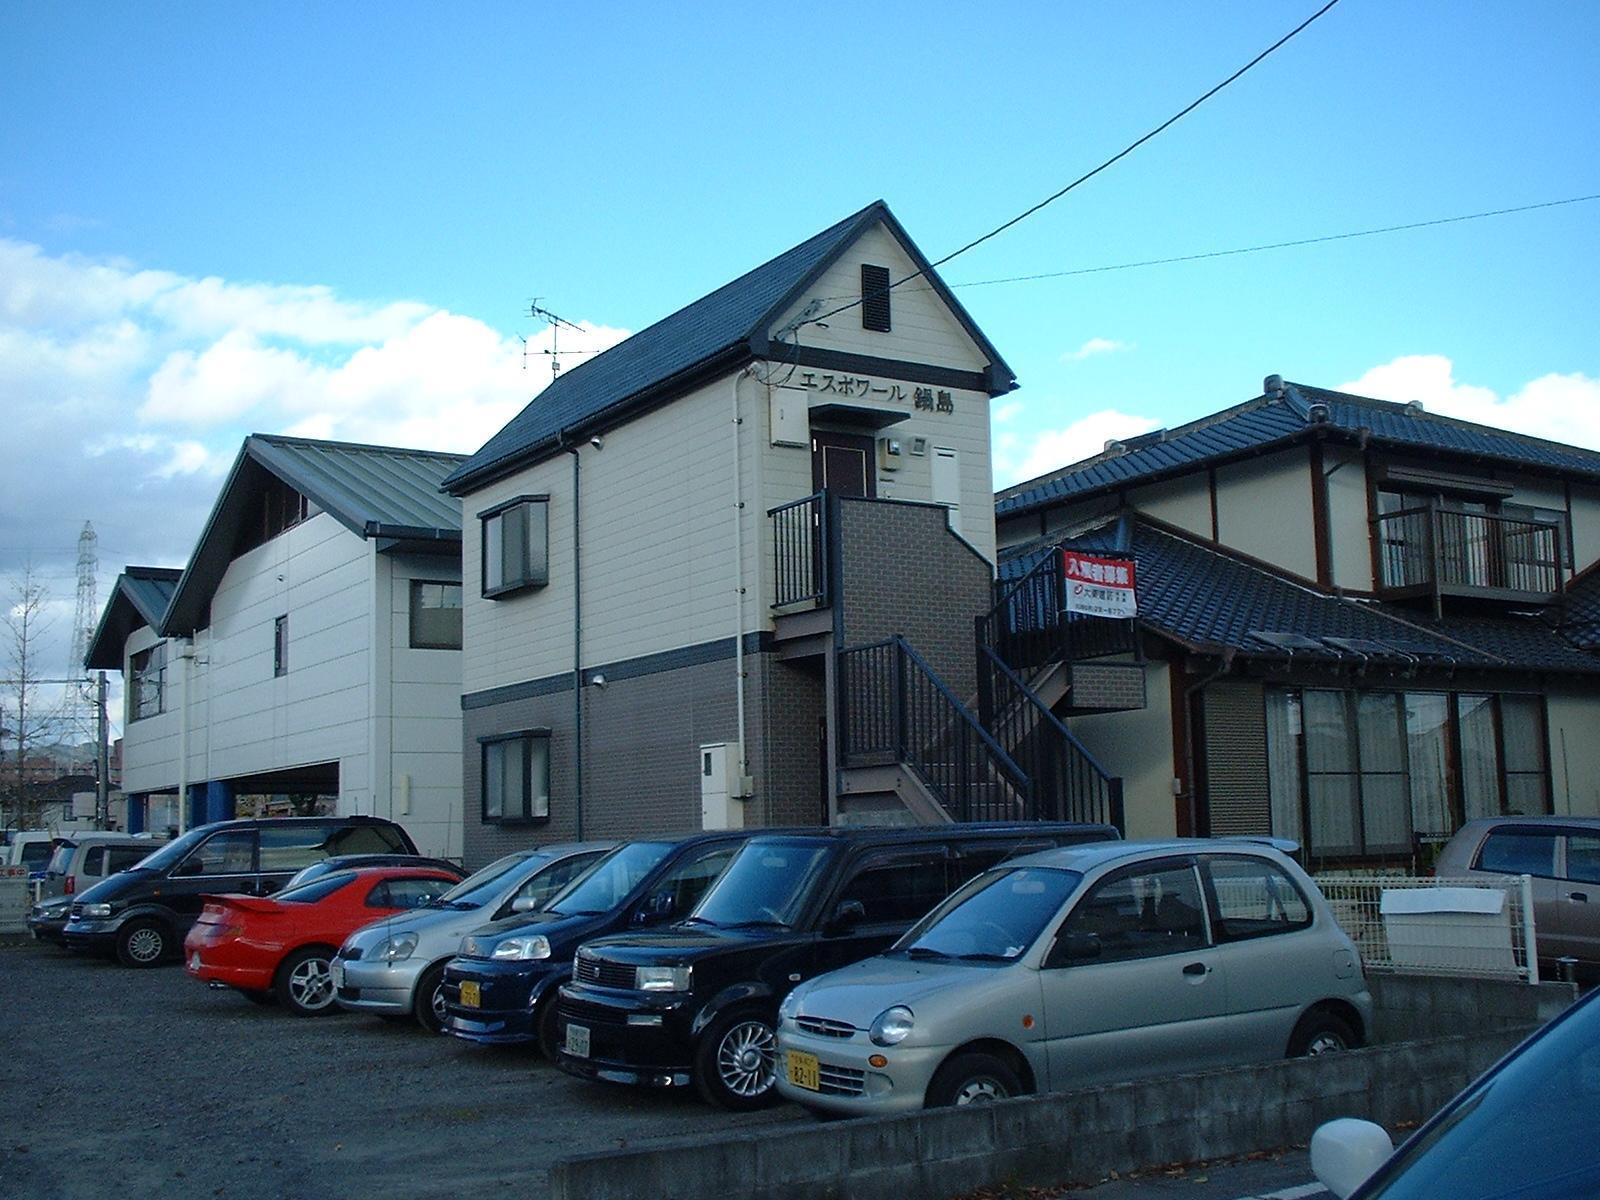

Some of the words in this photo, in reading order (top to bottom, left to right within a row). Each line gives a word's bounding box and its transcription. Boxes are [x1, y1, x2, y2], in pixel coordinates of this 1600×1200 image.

[799, 372, 908, 401] エスポワール
